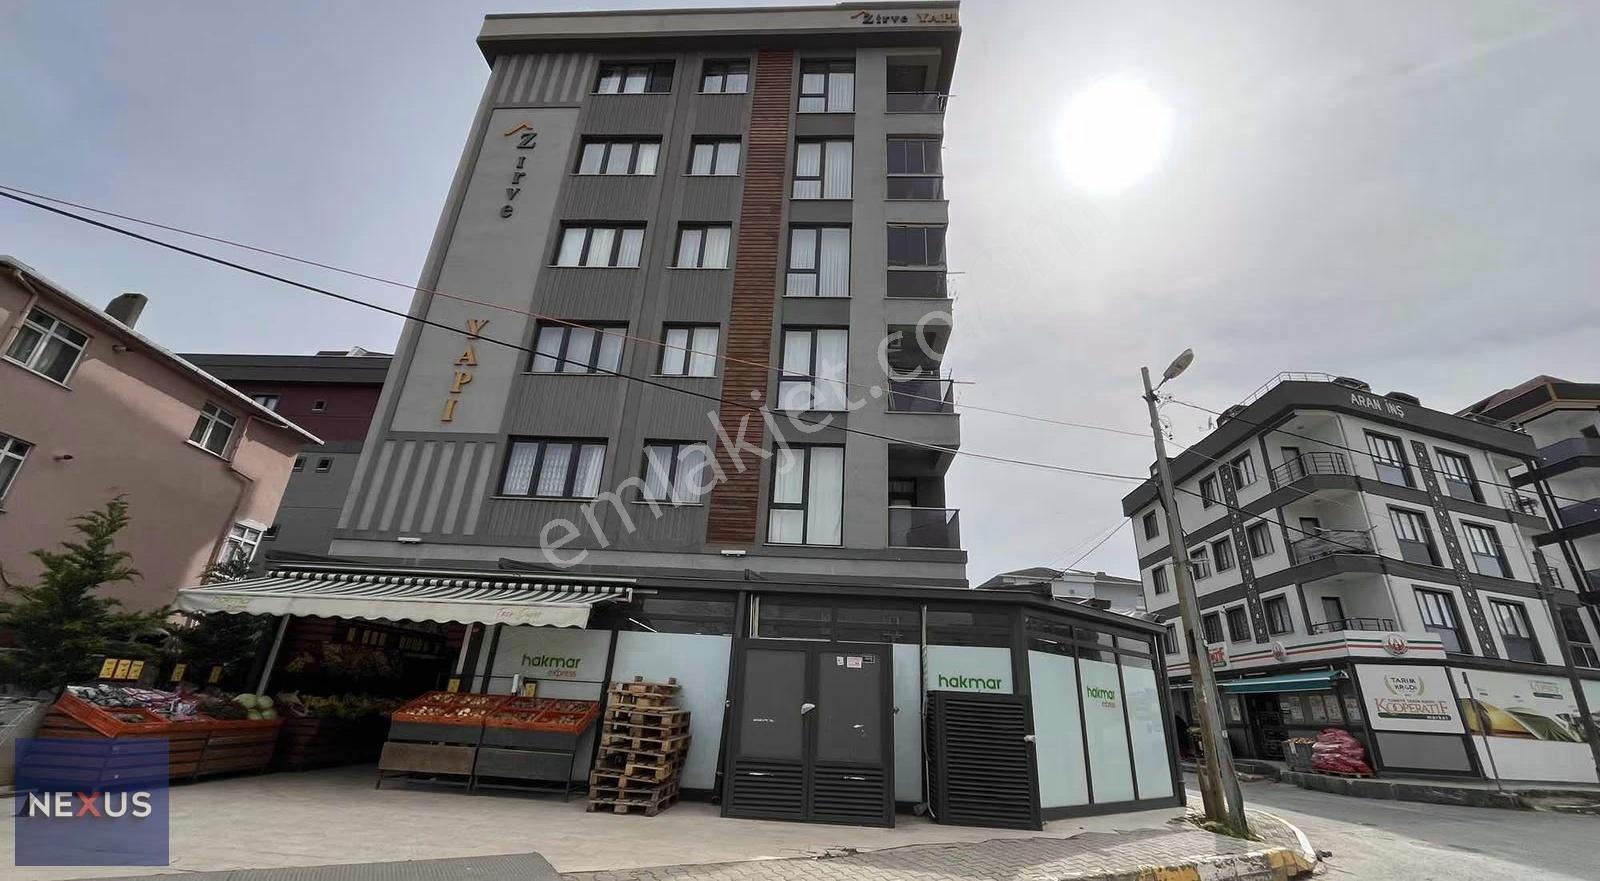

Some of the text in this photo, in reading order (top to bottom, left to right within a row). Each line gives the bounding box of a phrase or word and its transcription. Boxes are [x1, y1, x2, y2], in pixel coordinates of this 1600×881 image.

[441, 319, 489, 422] YAPI
[1351, 393, 1382, 410] ARAN
[521, 654, 581, 668] hakmar
[938, 674, 1002, 690] hakmar
[1086, 686, 1115, 700] hakmar
